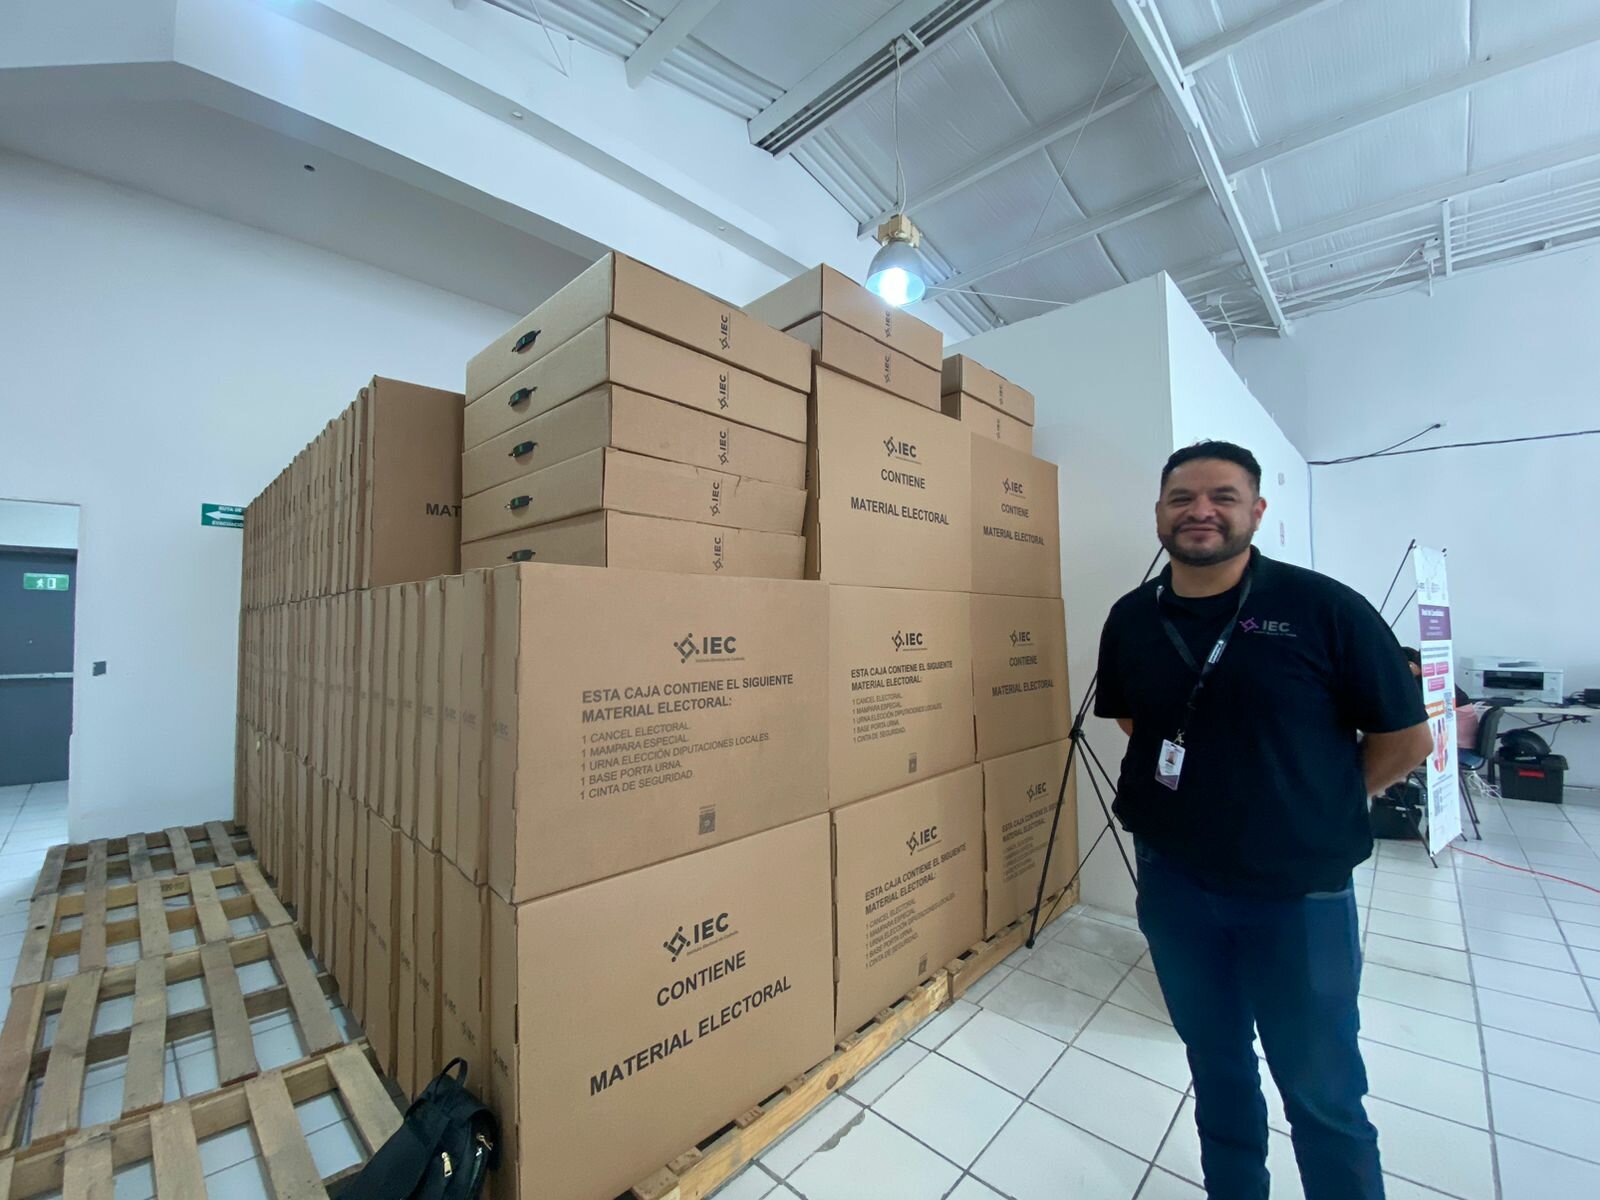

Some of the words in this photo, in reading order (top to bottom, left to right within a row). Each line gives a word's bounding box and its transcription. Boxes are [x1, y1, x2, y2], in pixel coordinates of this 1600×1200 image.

[719, 374, 727, 396] IEC
[719, 431, 727, 454] IEC
[899, 441, 917, 458] IEC
[881, 468, 926, 489] CONTIENE
[1010, 482, 1023, 494] IEC
[712, 481, 720, 504] IEC
[851, 497, 899, 517] MATERIAL
[901, 505, 949, 525] ELECTORAL
[1001, 503, 1029, 518] CONTIENE
[983, 525, 1013, 540] MATERIAL
[1014, 531, 1045, 546] ELECTORAL
[714, 537, 722, 559] IEC
[1263, 620, 1290, 632] IEC
[703, 636, 736, 654] IEC
[905, 632, 923, 646] IEC
[1019, 631, 1031, 642] IEC
[851, 668, 869, 678] ESTA
[870, 667, 887, 676] CAJA
[888, 663, 918, 674] CONTIENE
[919, 663, 926, 671] EL
[927, 661, 953, 670] SIGUIENTE
[1009, 656, 1038, 667] CONTIENE
[582, 689, 621, 704] ESTA
[624, 685, 660, 700] CAJA
[663, 680, 724, 697] CONTIENE
[726, 678, 740, 690] EL
[742, 674, 793, 688] SIGUIENTE
[852, 679, 885, 691] MATERIAL
[992, 683, 1022, 696] MATERIAL
[1023, 680, 1054, 692] ELECTORAL
[582, 704, 654, 723] MATERIAL
[658, 697, 732, 714] ELECTORAL:
[590, 729, 632, 743] CANCEL
[589, 758, 619, 771] URNA
[672, 738, 734, 757] DIPUTACIONES
[590, 741, 641, 757] MAMPARA
[589, 771, 618, 785] BASE
[620, 765, 653, 778] PORTA
[589, 784, 620, 799] CINTA
[622, 781, 635, 792] DE
[1035, 782, 1046, 795] IEC
[920, 826, 938, 845] IEC
[865, 886, 883, 901] ESTA
[884, 877, 902, 892] CAJA
[903, 861, 932, 882] CONTIENE
[933, 857, 940, 867] EL
[865, 891, 899, 915] MATERIAL
[694, 912, 728, 944] IEC
[657, 951, 746, 1006] CONTIENE
[590, 1029, 693, 1096] MATERIAL
[698, 976, 791, 1038] ELECTORAL
